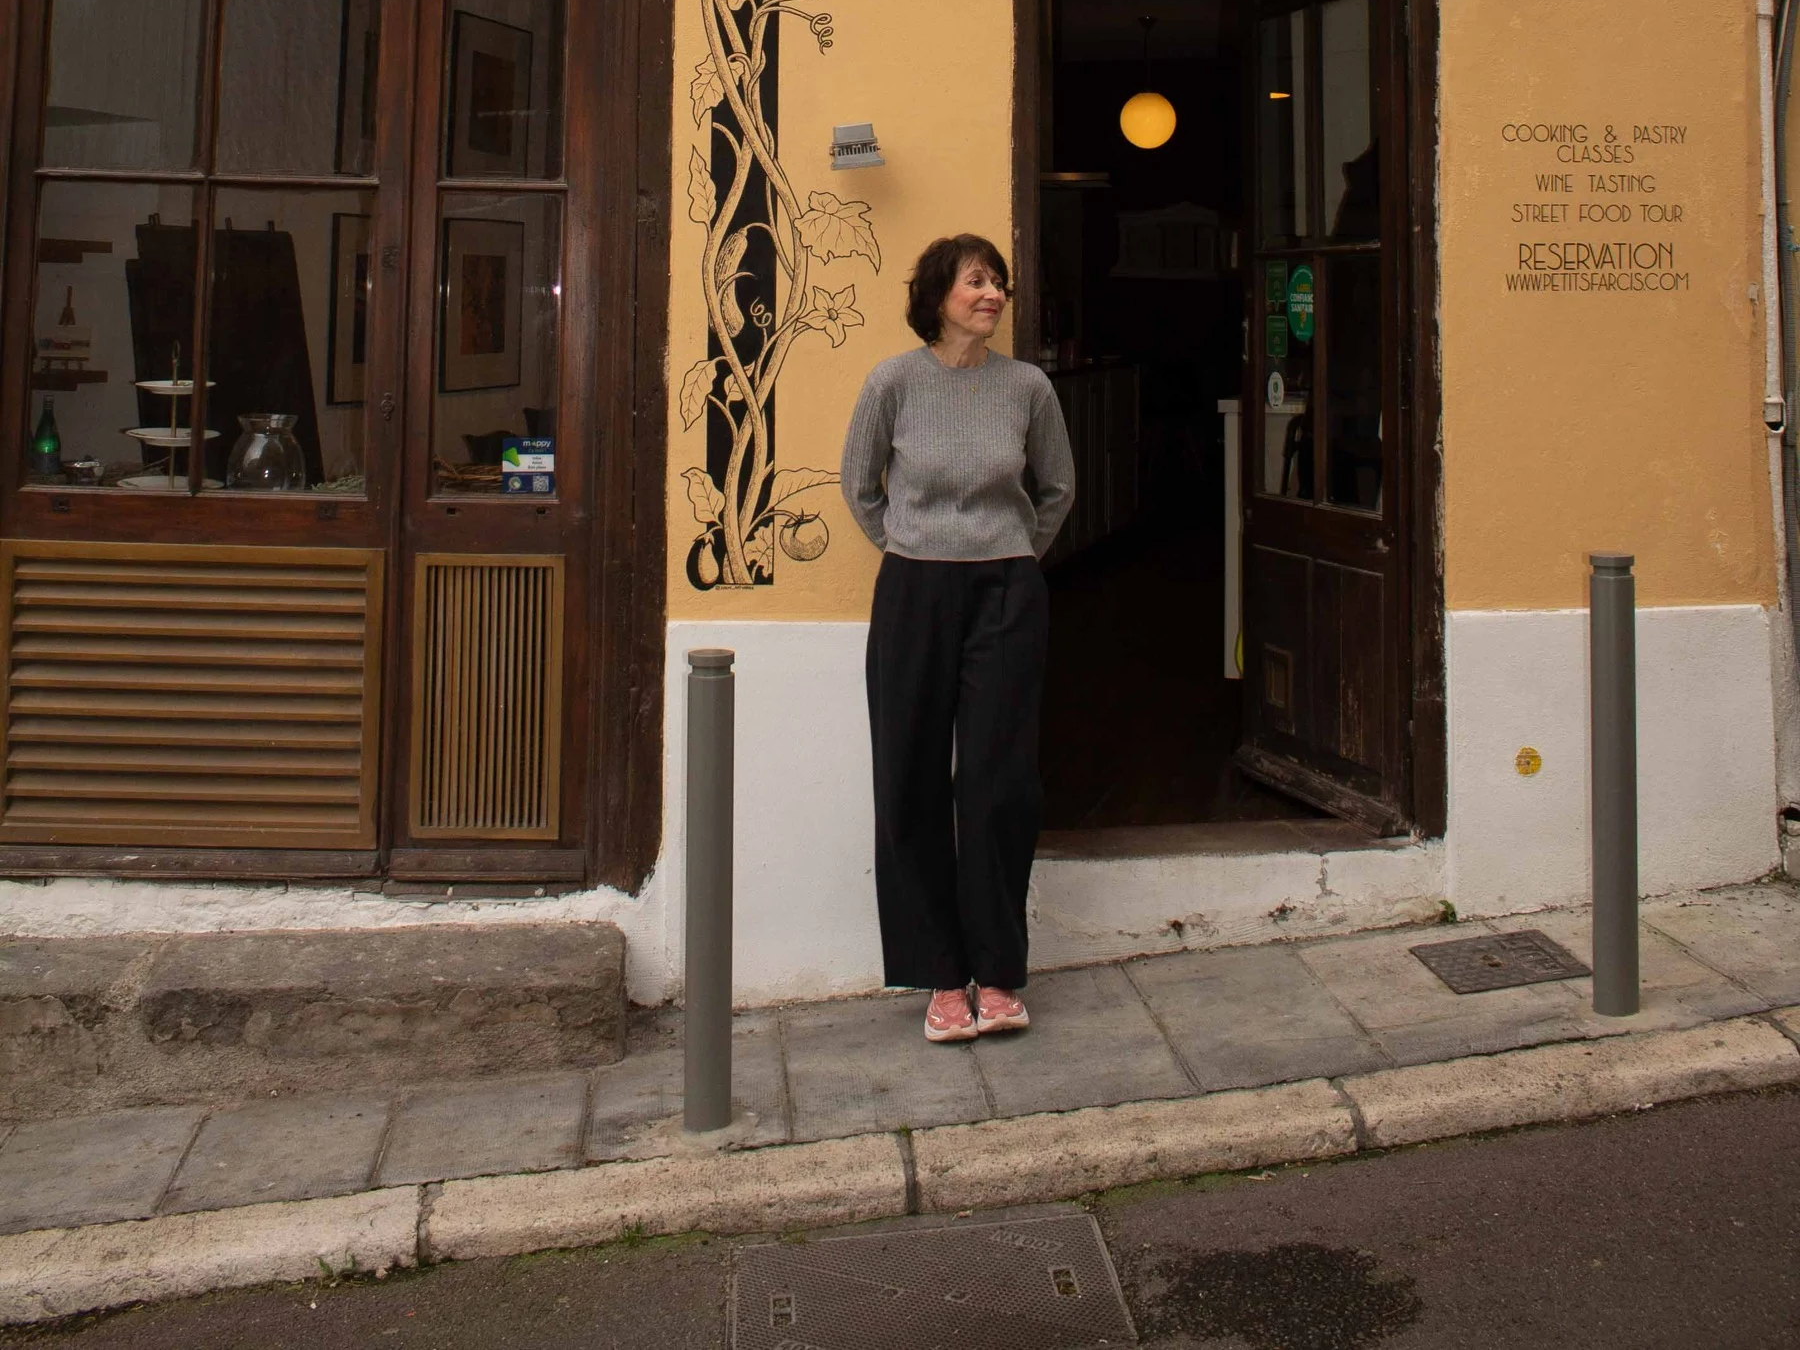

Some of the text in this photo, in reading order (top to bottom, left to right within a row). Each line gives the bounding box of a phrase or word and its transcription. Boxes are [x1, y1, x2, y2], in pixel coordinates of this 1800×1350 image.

[1501, 123, 1688, 144] COOKING & PASTRY
[1556, 144, 1635, 164] CLASSES
[1535, 173, 1656, 193] WINE TASTING
[1511, 203, 1684, 223] STREET FOOD TOUR
[1518, 242, 1674, 271] RESERVATION
[1290, 293, 1314, 303] CONFIANC
[1291, 303, 1314, 313] SANITAIR
